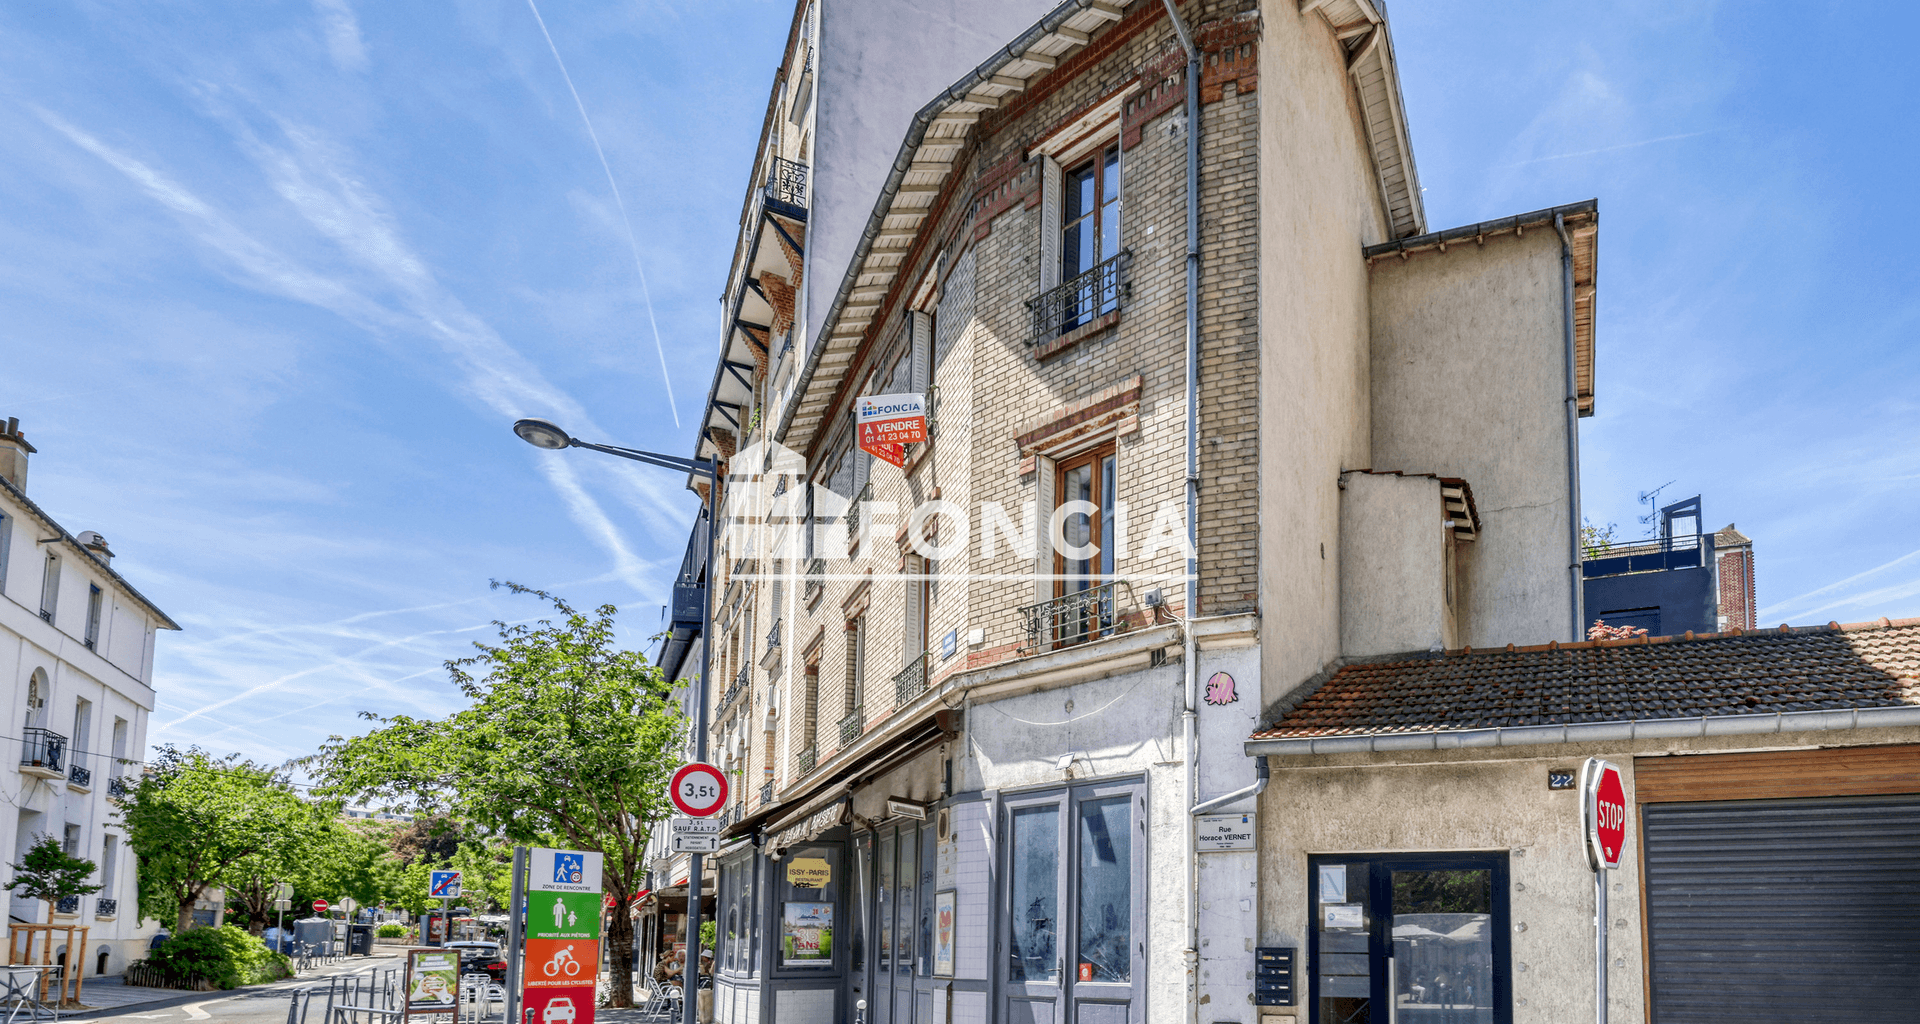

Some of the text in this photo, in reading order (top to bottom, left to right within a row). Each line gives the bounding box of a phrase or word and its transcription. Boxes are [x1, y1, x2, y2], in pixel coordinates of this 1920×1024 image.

[878, 403, 920, 414] FONCIA
[865, 420, 920, 435] À VENDRE
[1599, 800, 1623, 831] STOP
[1224, 833, 1251, 841] VERNET
[798, 941, 820, 949] ANS
